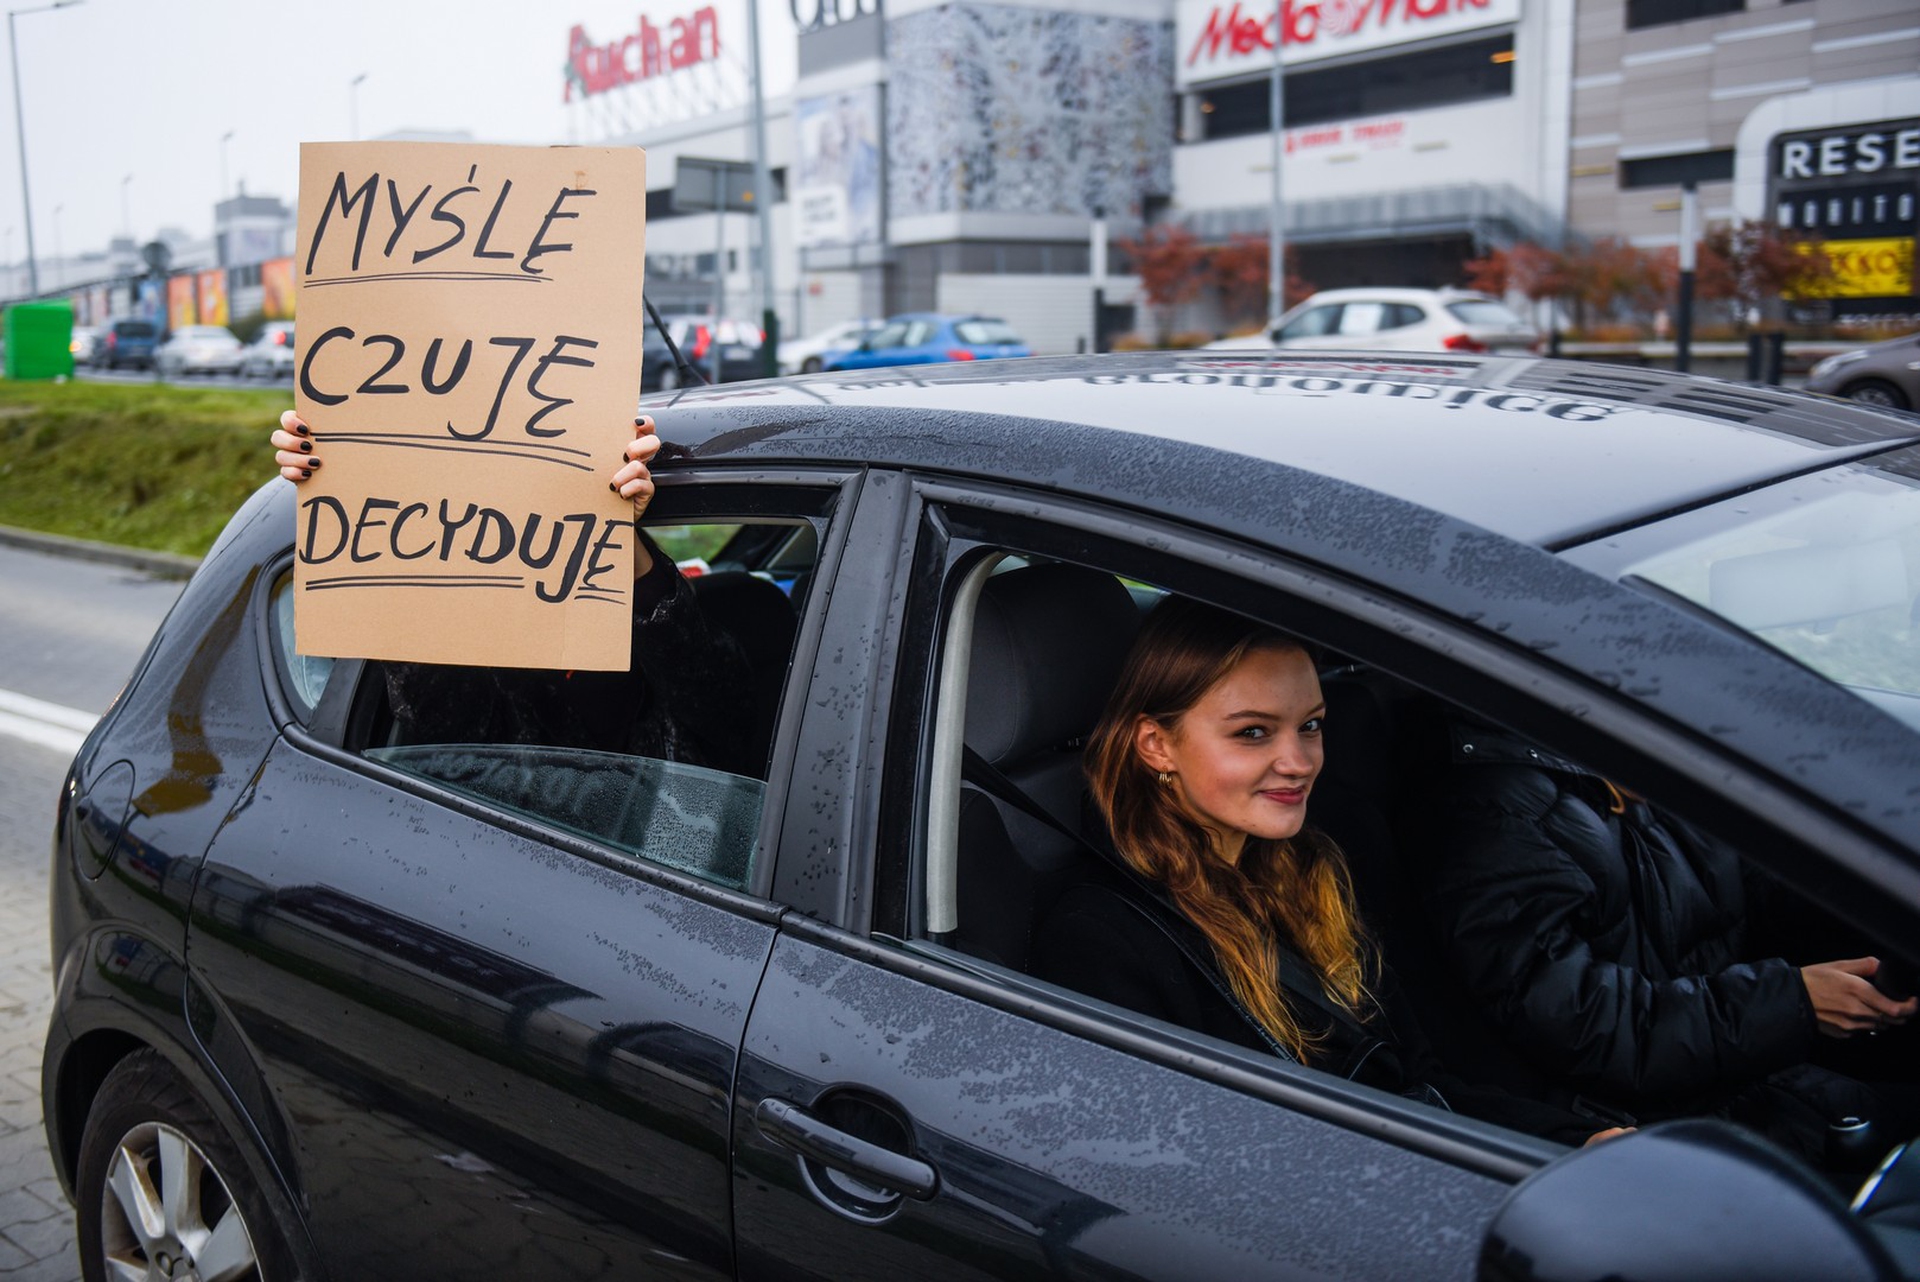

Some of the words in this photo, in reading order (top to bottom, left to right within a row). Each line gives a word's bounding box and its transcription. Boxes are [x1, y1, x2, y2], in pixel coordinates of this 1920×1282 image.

[563, 6, 720, 103] Auchan
[1783, 129, 1920, 179] RESE
[305, 164, 597, 275] MYŚLĘ
[300, 326, 599, 441] CZUJĘ
[299, 495, 634, 604] DECYDUJĘ
